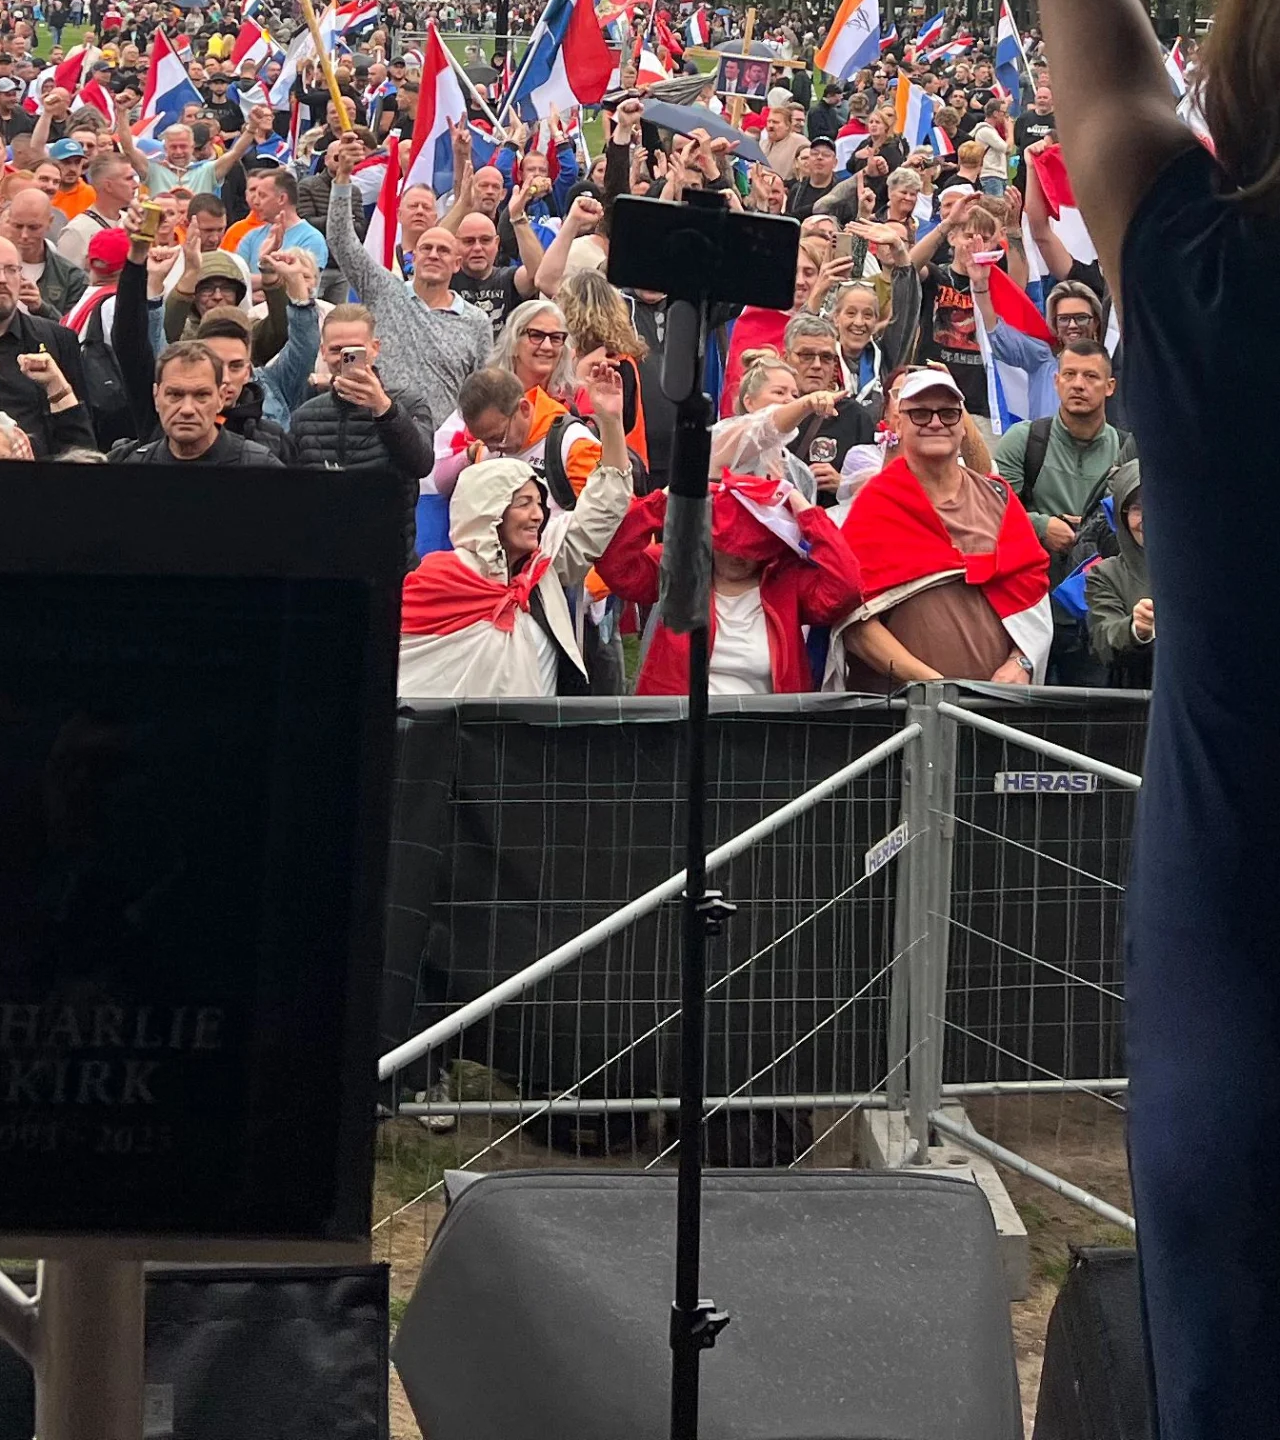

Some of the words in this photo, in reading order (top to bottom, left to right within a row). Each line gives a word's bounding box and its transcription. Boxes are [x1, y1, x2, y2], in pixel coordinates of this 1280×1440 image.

[1003, 773, 1089, 791] HERAS
[870, 829, 903, 870] HERAS
[4, 1057, 162, 1105] KIRK
